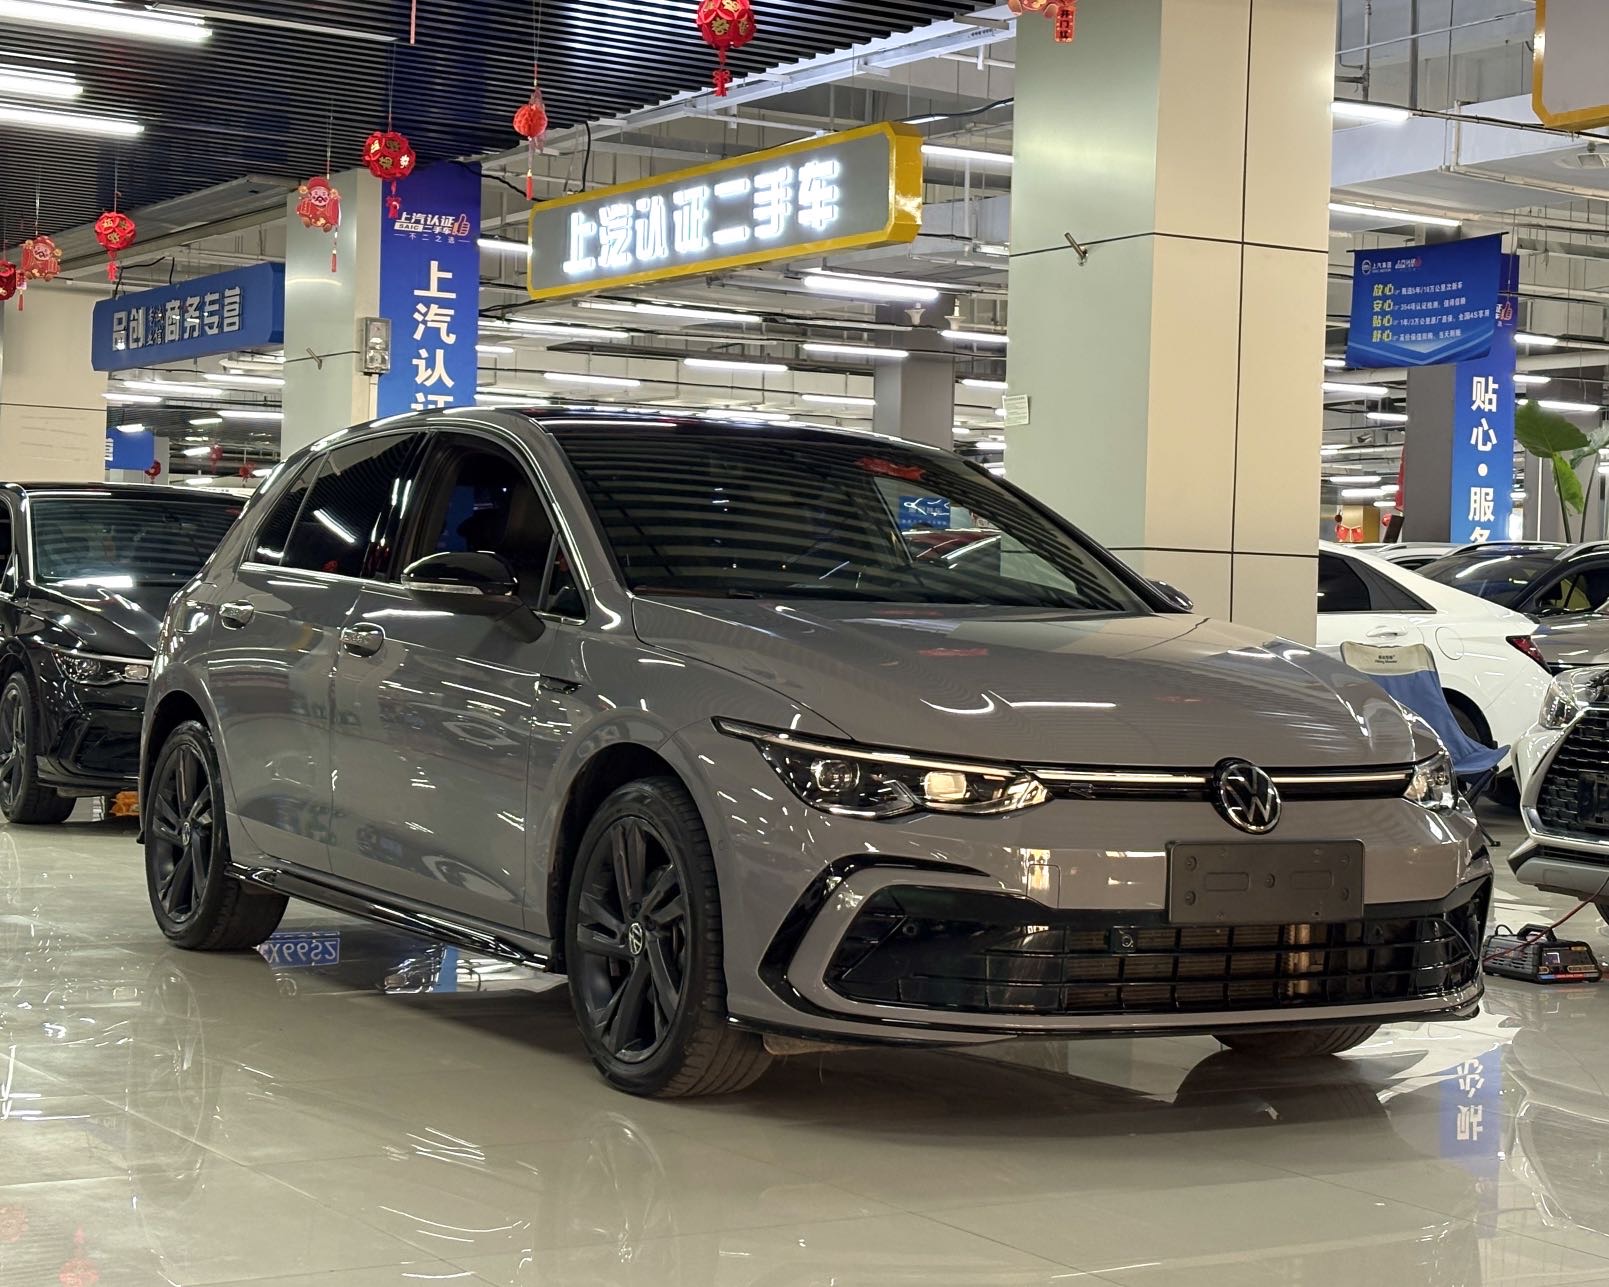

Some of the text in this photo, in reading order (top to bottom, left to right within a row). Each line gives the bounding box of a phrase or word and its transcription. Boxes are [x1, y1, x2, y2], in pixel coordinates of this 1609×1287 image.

[396, 211, 456, 228] 上汽认证
[562, 160, 840, 274] 上汽认证二手车
[398, 223, 420, 231] SAIC
[423, 225, 452, 235] 二手车
[1373, 283, 1394, 297] 放心
[1372, 299, 1393, 312] 安心
[1372, 315, 1393, 327] 贴心
[1372, 330, 1393, 342] 舒心
